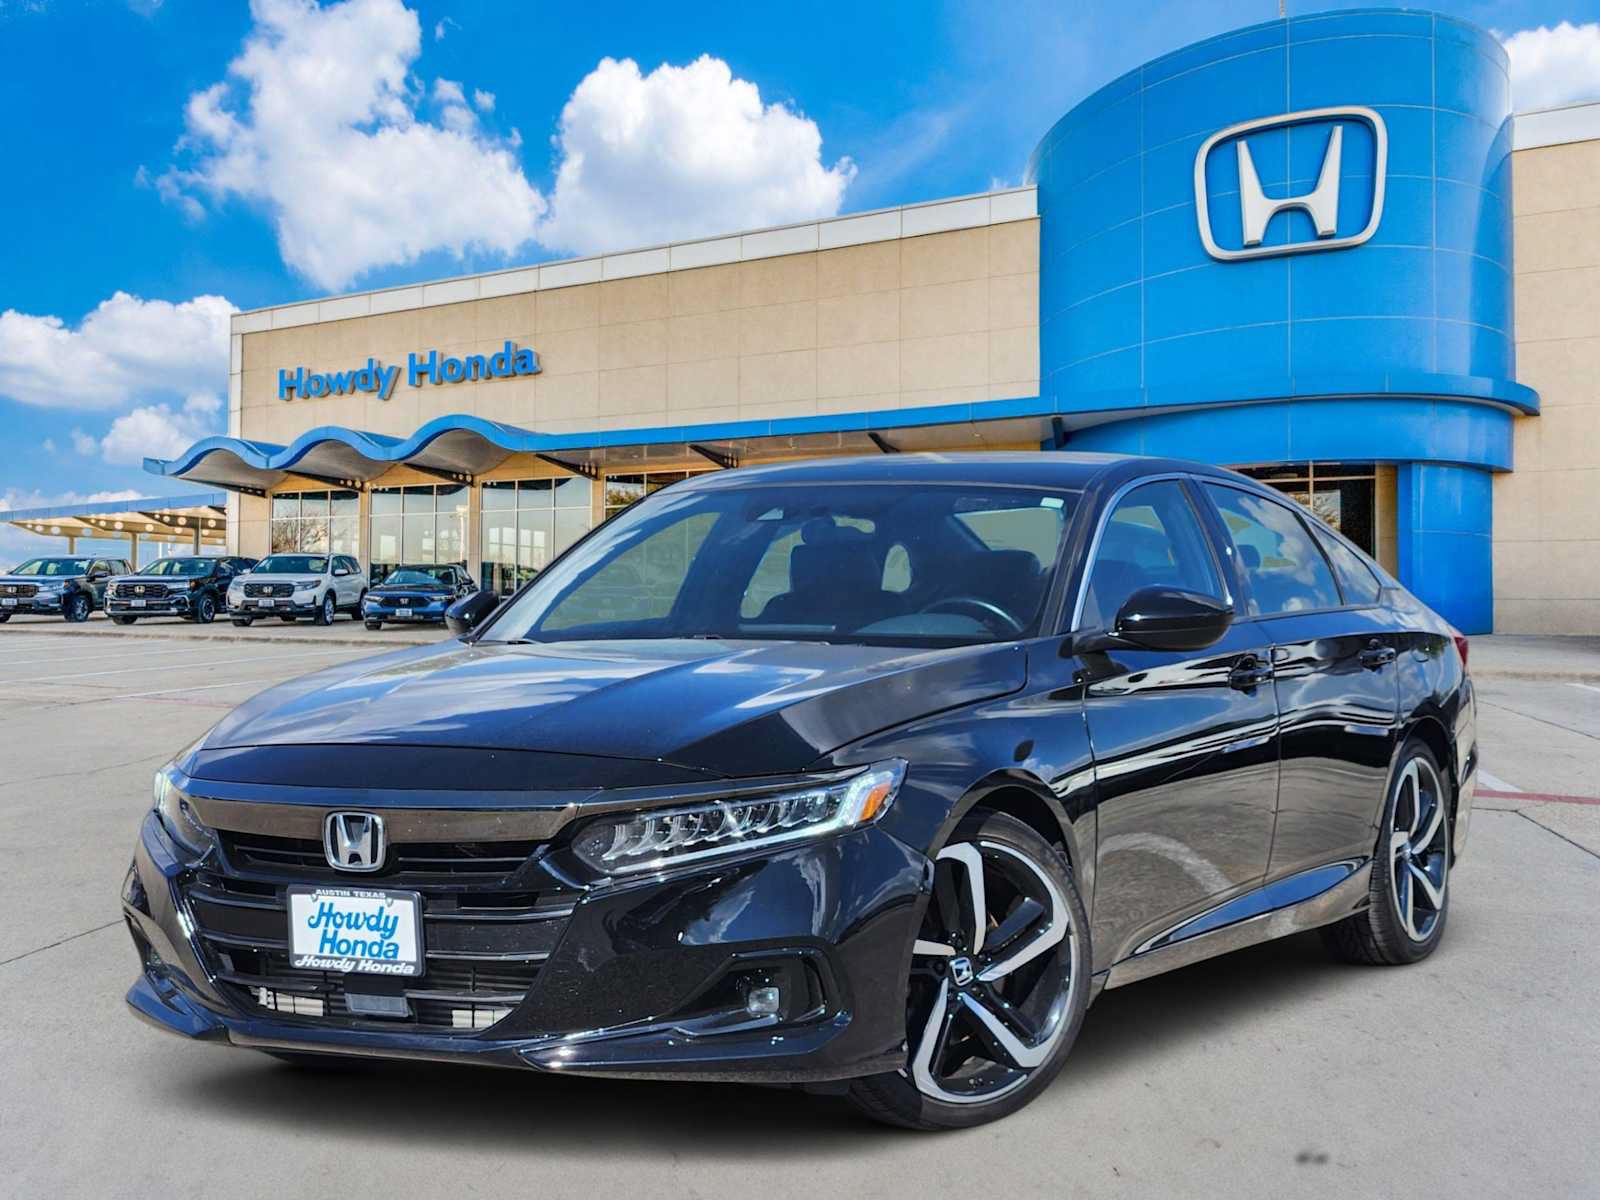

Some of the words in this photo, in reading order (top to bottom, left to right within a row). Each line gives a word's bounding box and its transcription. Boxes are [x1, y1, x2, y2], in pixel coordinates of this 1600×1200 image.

[278, 358, 400, 401] Howdy
[408, 340, 541, 388] Honda
[315, 889, 350, 897] AUSTIN
[353, 890, 386, 899] TEXAS
[307, 902, 399, 940] Howdy
[319, 929, 400, 960] Honda
[295, 955, 355, 973] Howdy
[357, 959, 415, 975] Honda
